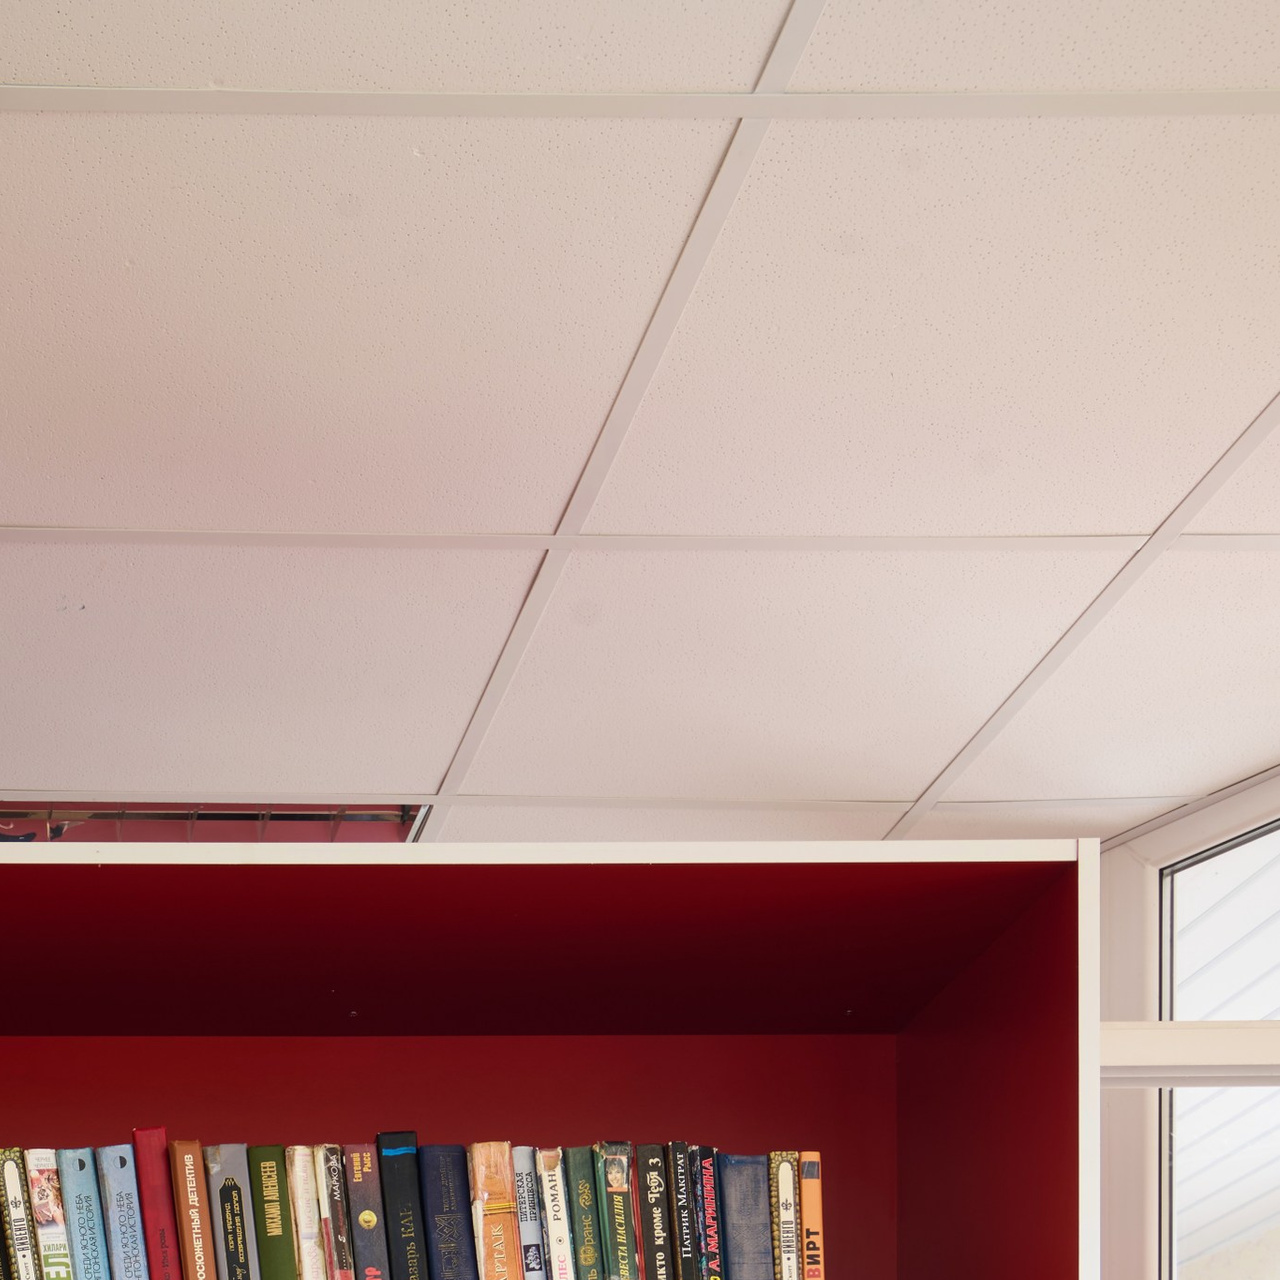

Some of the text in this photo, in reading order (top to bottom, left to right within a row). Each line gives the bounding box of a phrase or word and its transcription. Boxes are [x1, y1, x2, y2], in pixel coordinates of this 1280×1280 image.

[350, 1152, 363, 1182] Евгений
[362, 1152, 372, 1172] Рысс
[184, 1154, 199, 1206] ДЕТЕКТИВ
[515, 1172, 528, 1223] ПИТЕРСКАЯ
[526, 1171, 538, 1221] ПРИНЦЕССА
[75, 1193, 84, 1215] НЕБА
[116, 1191, 125, 1213] НЕБА
[261, 1161, 283, 1236] МИХАИЛ АЛЕКСЕЕВ
[701, 1158, 721, 1272] А. МАРИНИНА
[78, 1216, 89, 1251] ЯСНОГО
[118, 1214, 129, 1249] ЯСНОГО
[613, 1194, 627, 1243] НАСИЛИЯ
[580, 1214, 598, 1266] Франс
[805, 1228, 821, 1279] ВИРТ
[22, 1262, 30, 1280] Скотт
[82, 1251, 94, 1280] СРЕДИ
[123, 1250, 134, 1279] СРЕДИ
